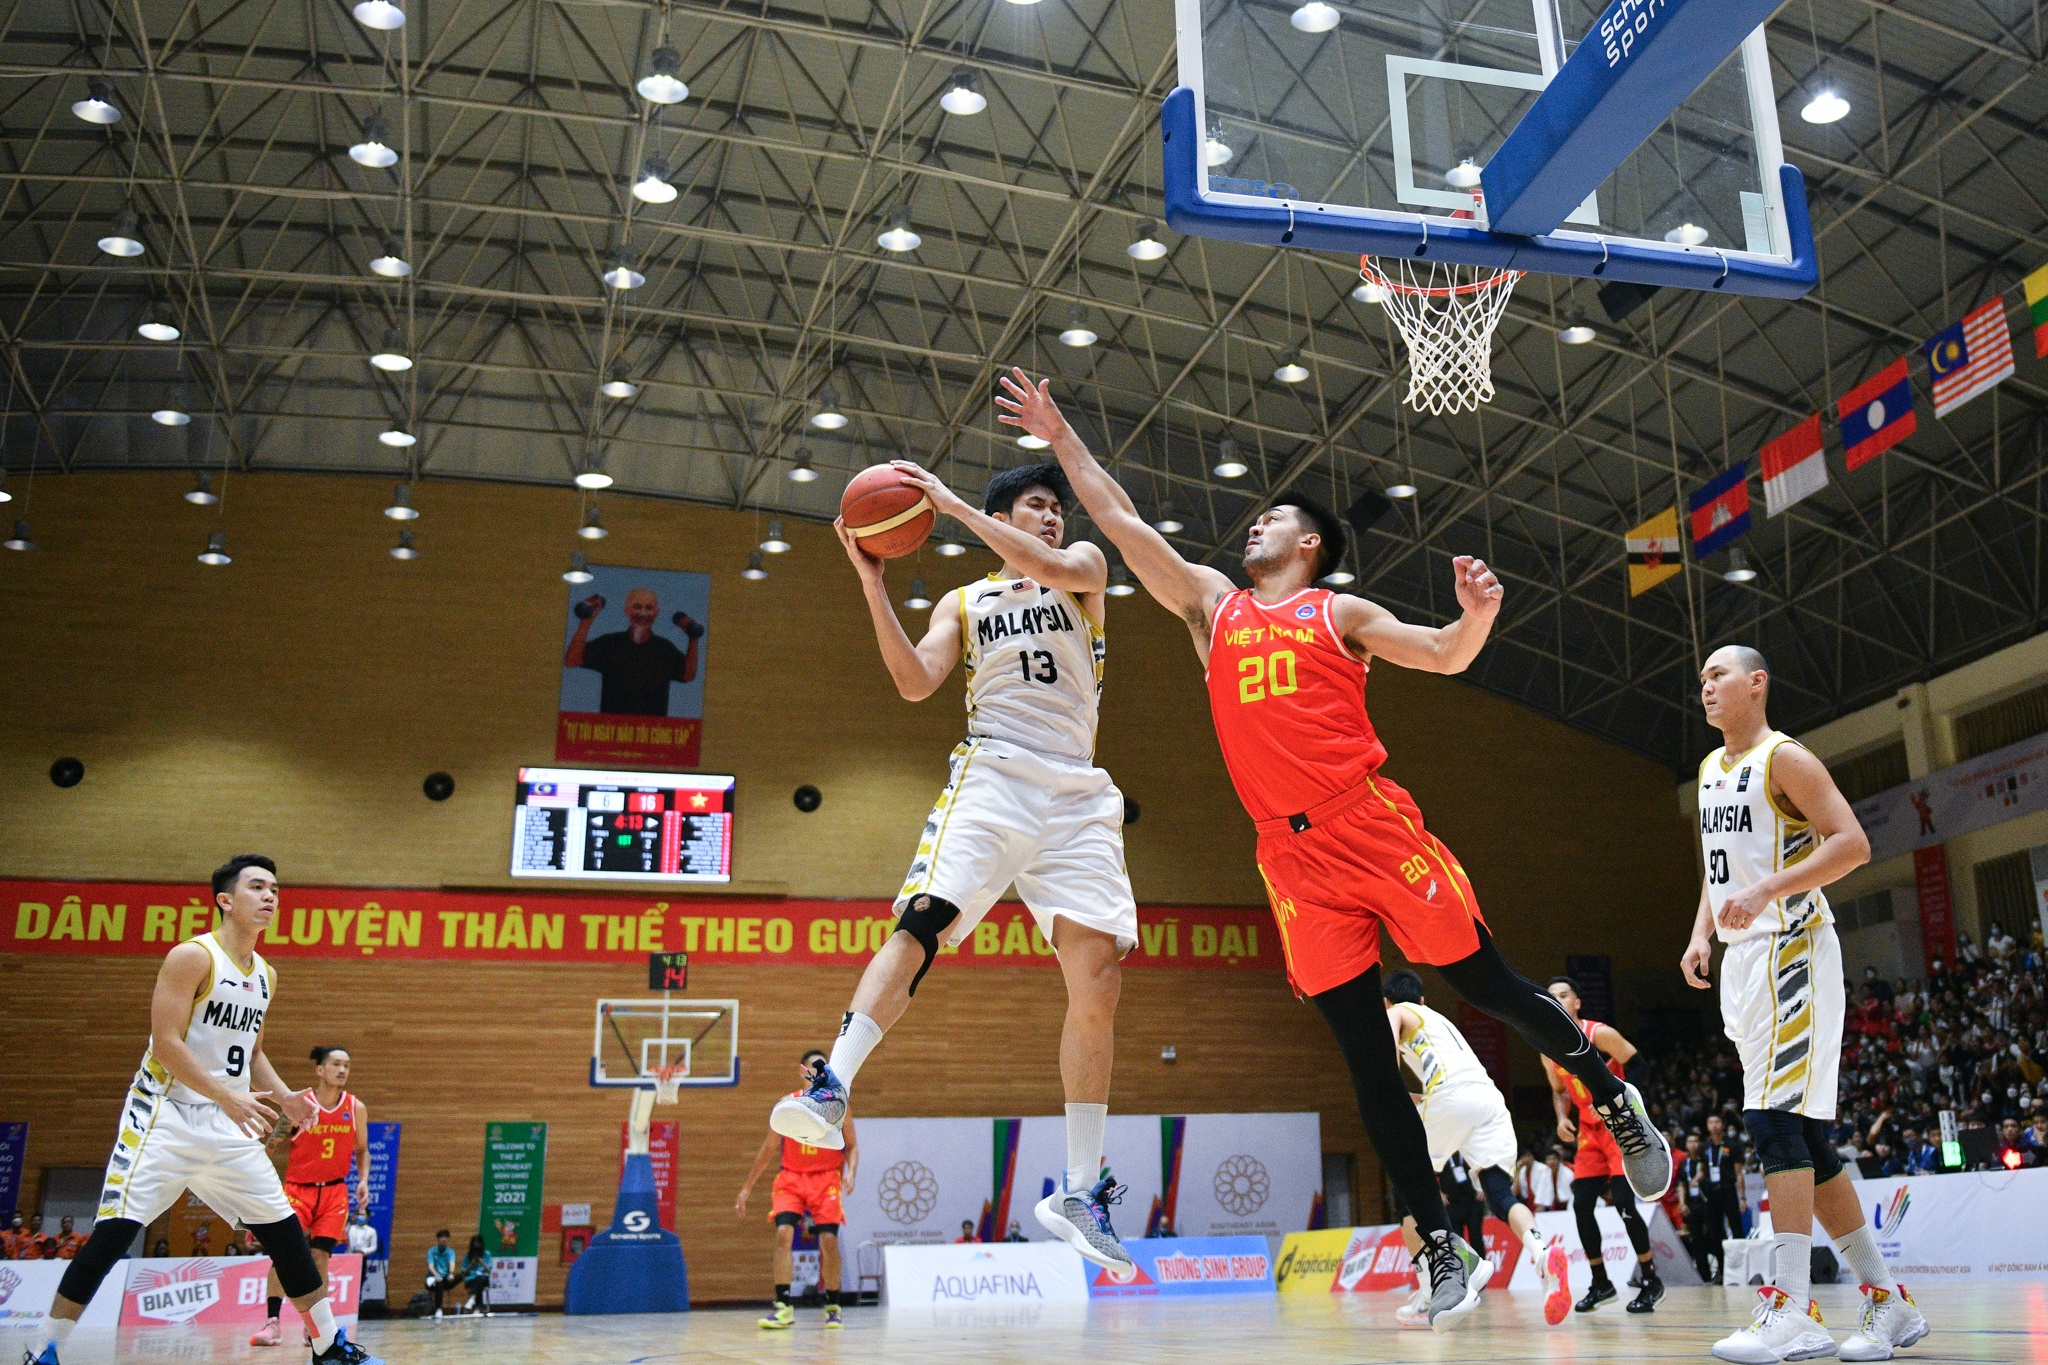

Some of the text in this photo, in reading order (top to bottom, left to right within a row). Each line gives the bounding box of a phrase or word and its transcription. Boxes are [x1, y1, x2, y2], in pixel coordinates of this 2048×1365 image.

[1601, 0, 1645, 46] Sch
[978, 603, 1074, 645] MALAYSIA
[1224, 623, 1315, 648] VIỆT NAM
[1019, 650, 1058, 684] 13
[1238, 649, 1297, 703] 20
[640, 795, 657, 811] 16
[614, 814, 644, 830] 4:13
[645, 839, 652, 850] 2
[1400, 853, 1430, 885] 20
[1709, 849, 1730, 885] 90
[15, 895, 127, 942] DÂN
[264, 902, 423, 955] LUYỆN
[438, 905, 565, 950] THÂN
[580, 902, 670, 951] THỂ
[680, 916, 794, 954] THEO
[1140, 917, 1180, 957] VĨ
[1190, 923, 1259, 965] ĐẠI
[664, 966, 686, 989] 14
[203, 1000, 265, 1033] MALAYS
[226, 1045, 245, 1077] 9
[321, 1138, 335, 1159] 3
[495, 1191, 526, 1204] 2021
[1203, 1256, 1231, 1280] SINH
[1231, 1256, 1267, 1279] GROUP
[143, 1282, 213, 1312] BIA VIỆT
[932, 1272, 1043, 1302] AQUAFINA
